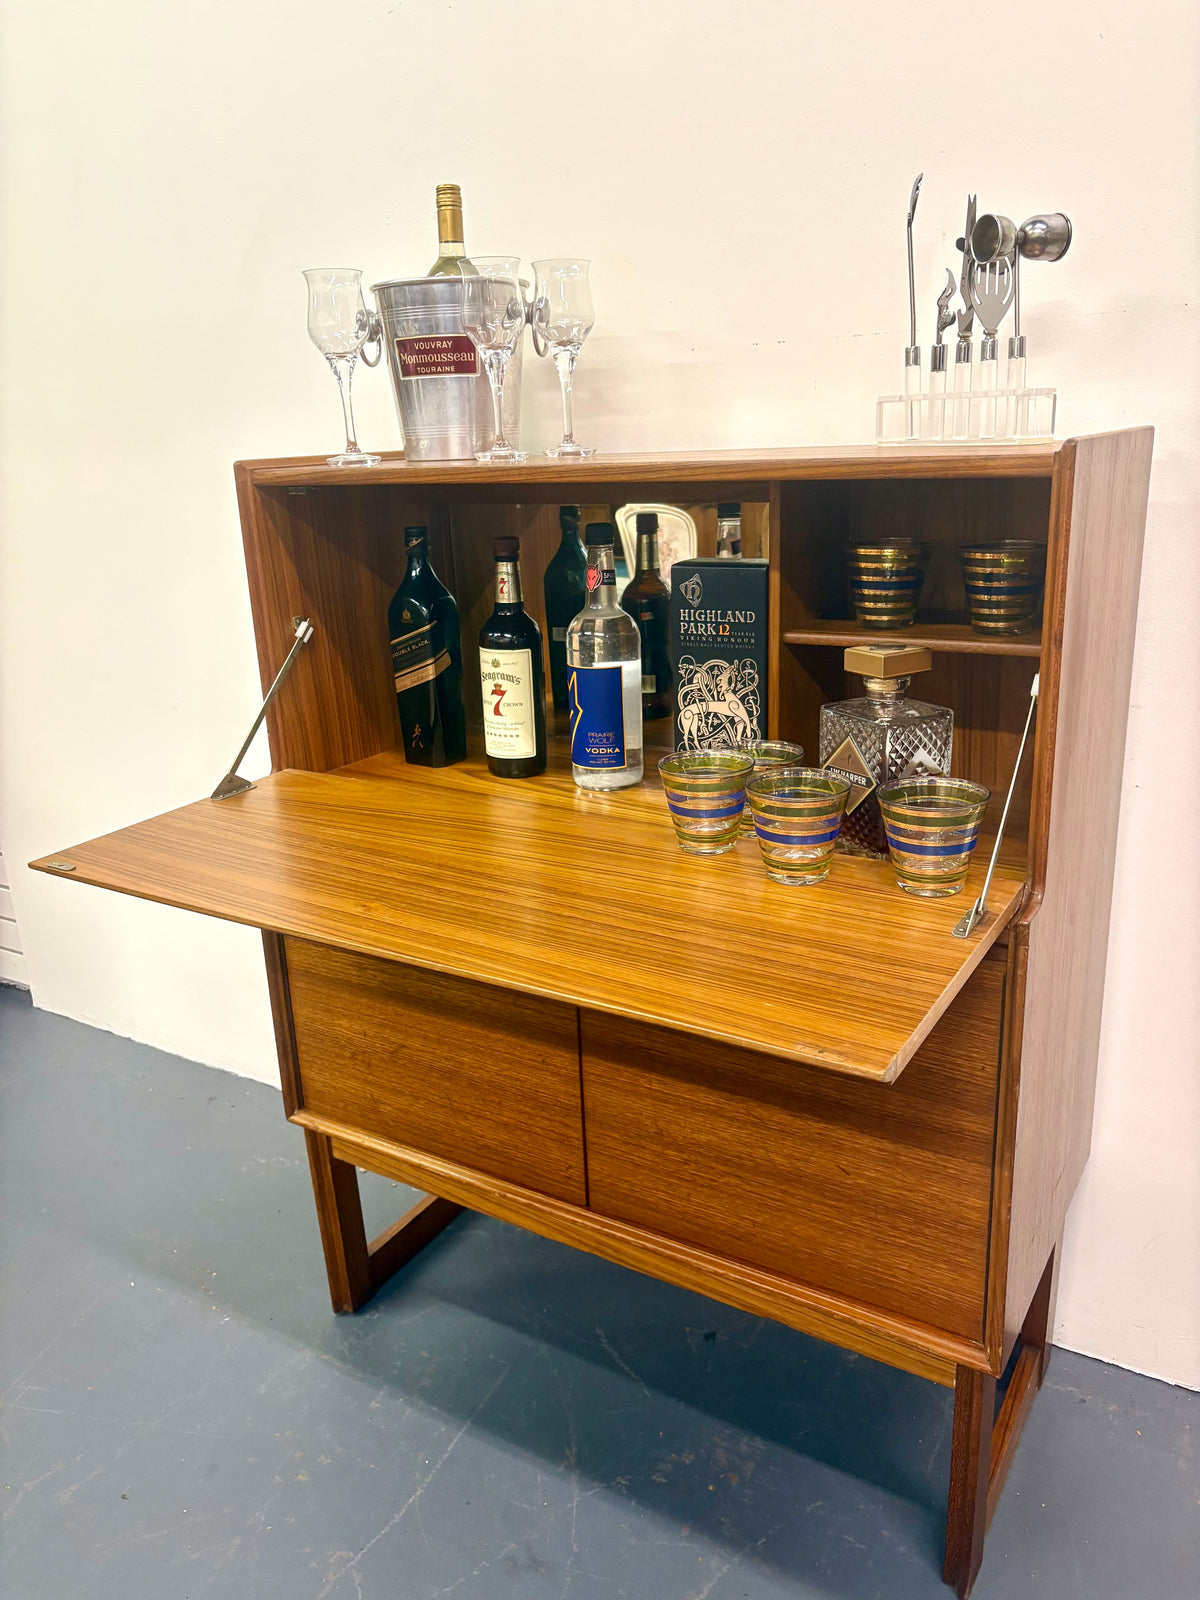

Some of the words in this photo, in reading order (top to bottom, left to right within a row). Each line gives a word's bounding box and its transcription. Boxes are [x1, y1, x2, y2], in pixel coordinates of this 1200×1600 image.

[414, 340, 453, 350] VOUVRAY
[400, 352, 475, 365] Monmousseau
[417, 365, 456, 373] TOURAINE
[499, 580, 506, 594] 7
[680, 609, 756, 623] HIGHLAND
[680, 622, 717, 637] PARK
[718, 624, 730, 636] 12
[392, 646, 412, 659] DOUBLE
[481, 671, 523, 685] Seagram's
[491, 689, 508, 717] 7
